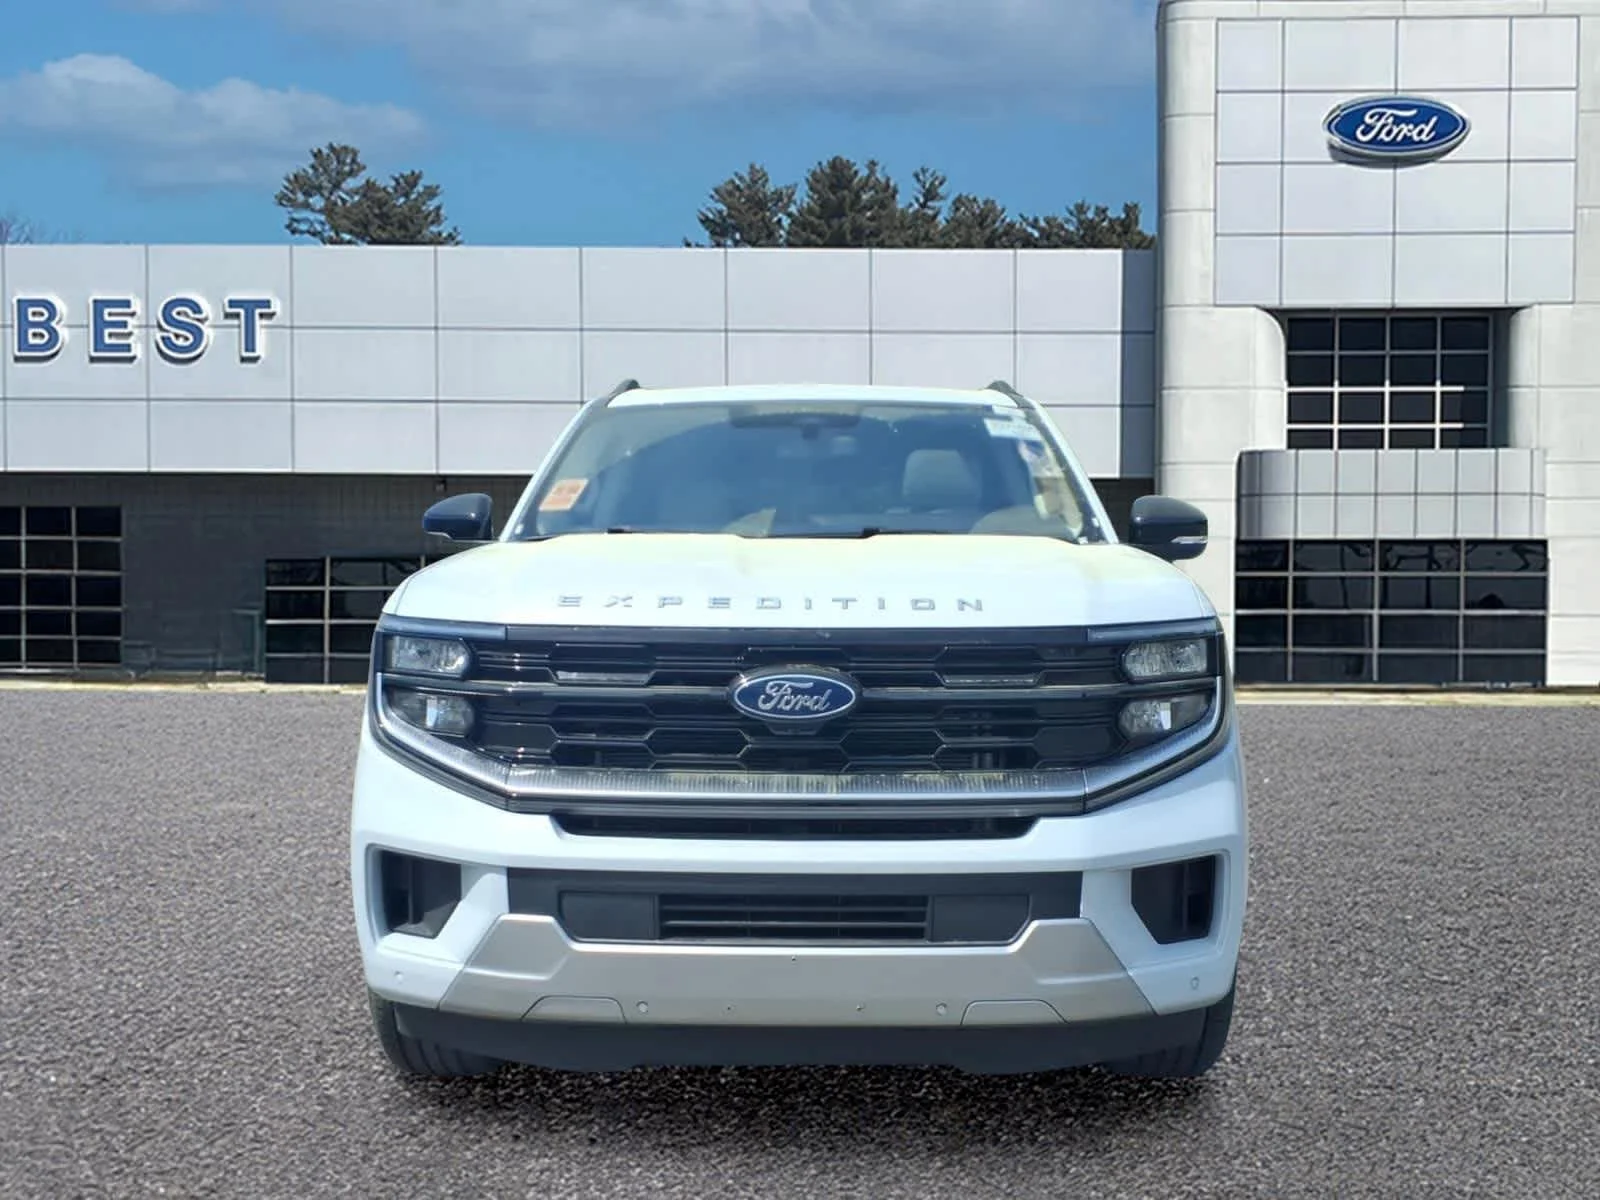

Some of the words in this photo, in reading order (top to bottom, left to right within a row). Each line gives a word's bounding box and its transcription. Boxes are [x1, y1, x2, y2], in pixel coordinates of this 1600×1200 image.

[1355, 108, 1439, 143] Ford
[13, 296, 276, 359] BEST
[558, 596, 983, 612] EXPEDITION
[757, 680, 834, 712] Ford
